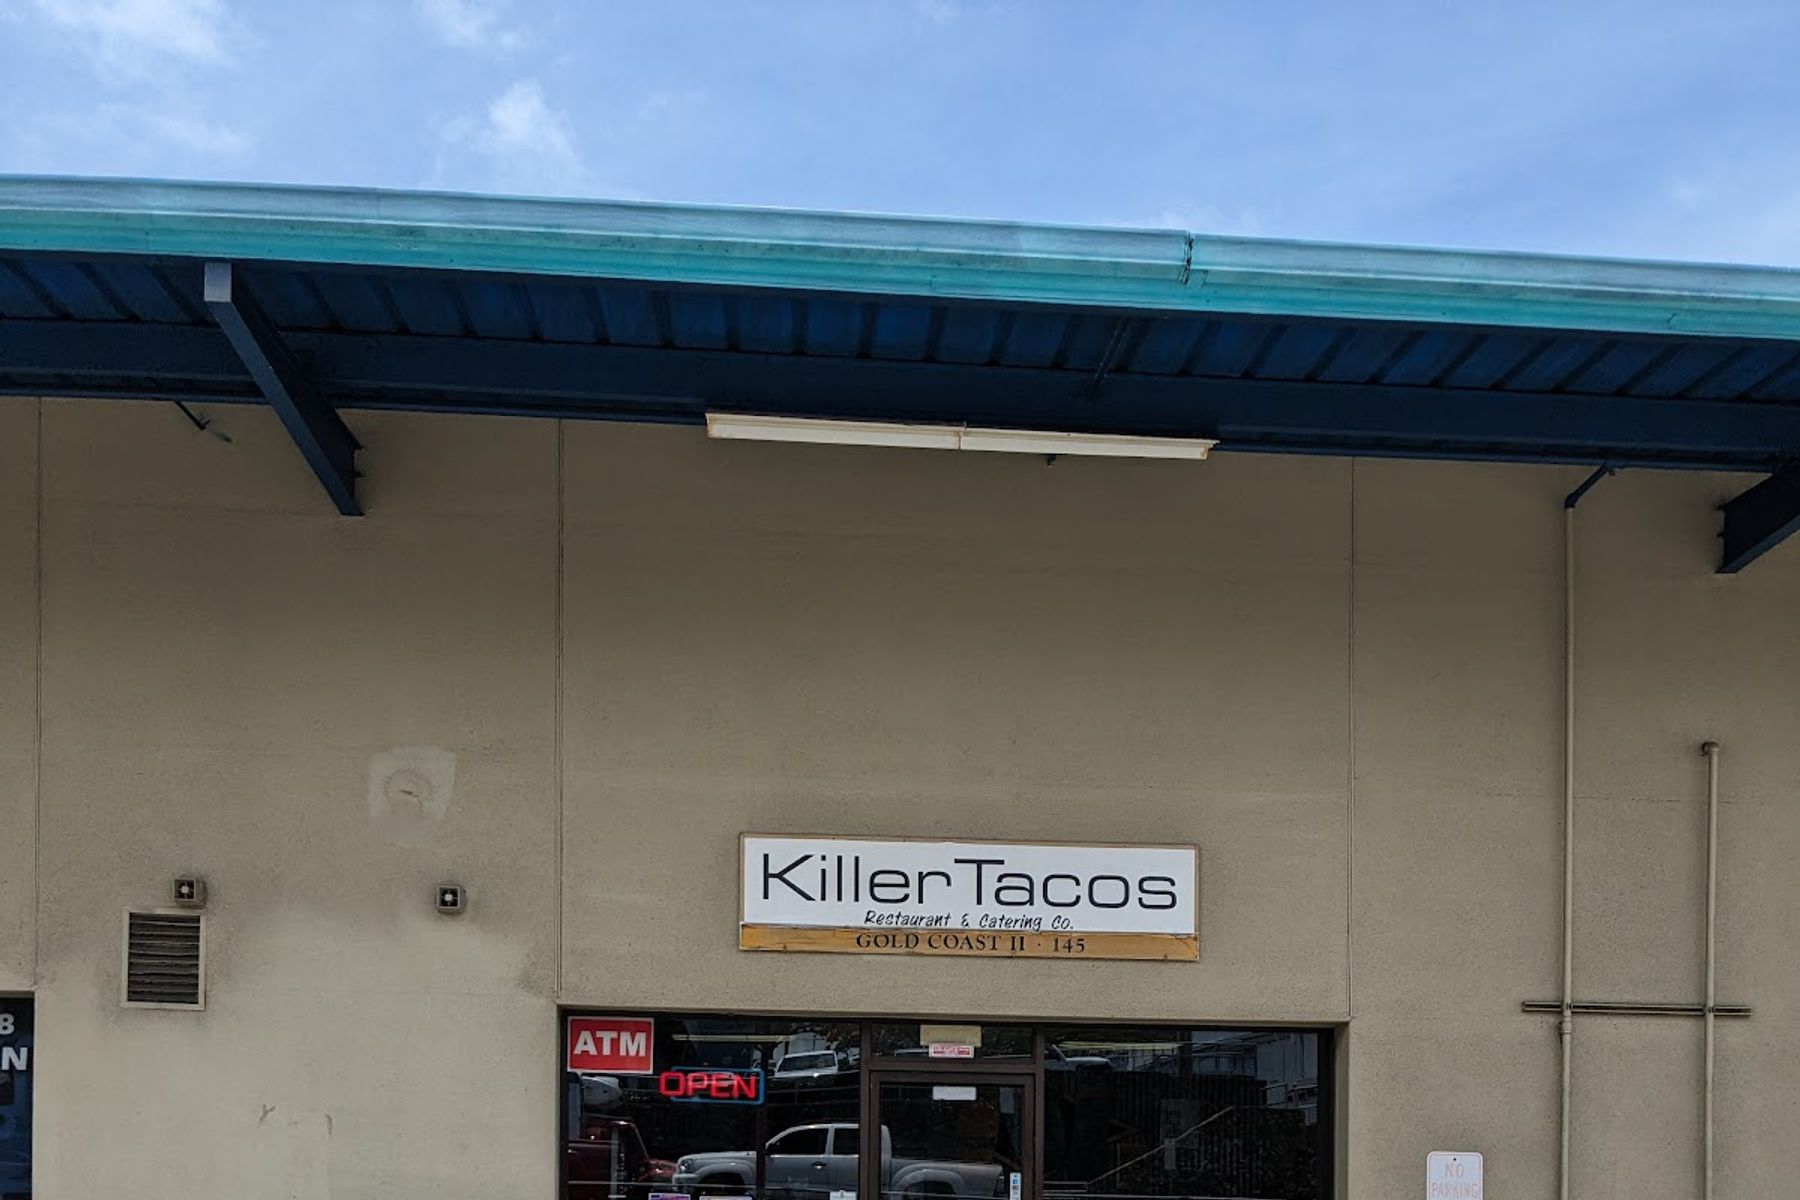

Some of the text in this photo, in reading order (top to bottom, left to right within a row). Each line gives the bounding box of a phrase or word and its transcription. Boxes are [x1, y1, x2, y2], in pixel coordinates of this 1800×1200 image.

[863, 909, 1075, 931] Restaurant & Catering Co.
[856, 933, 1086, 954] GOLD COAST II 145
[574, 1031, 646, 1057] ATM
[660, 1072, 757, 1098] OPEN
[1444, 1163, 1465, 1178] NO
[1431, 1183, 1479, 1199] PARKING
